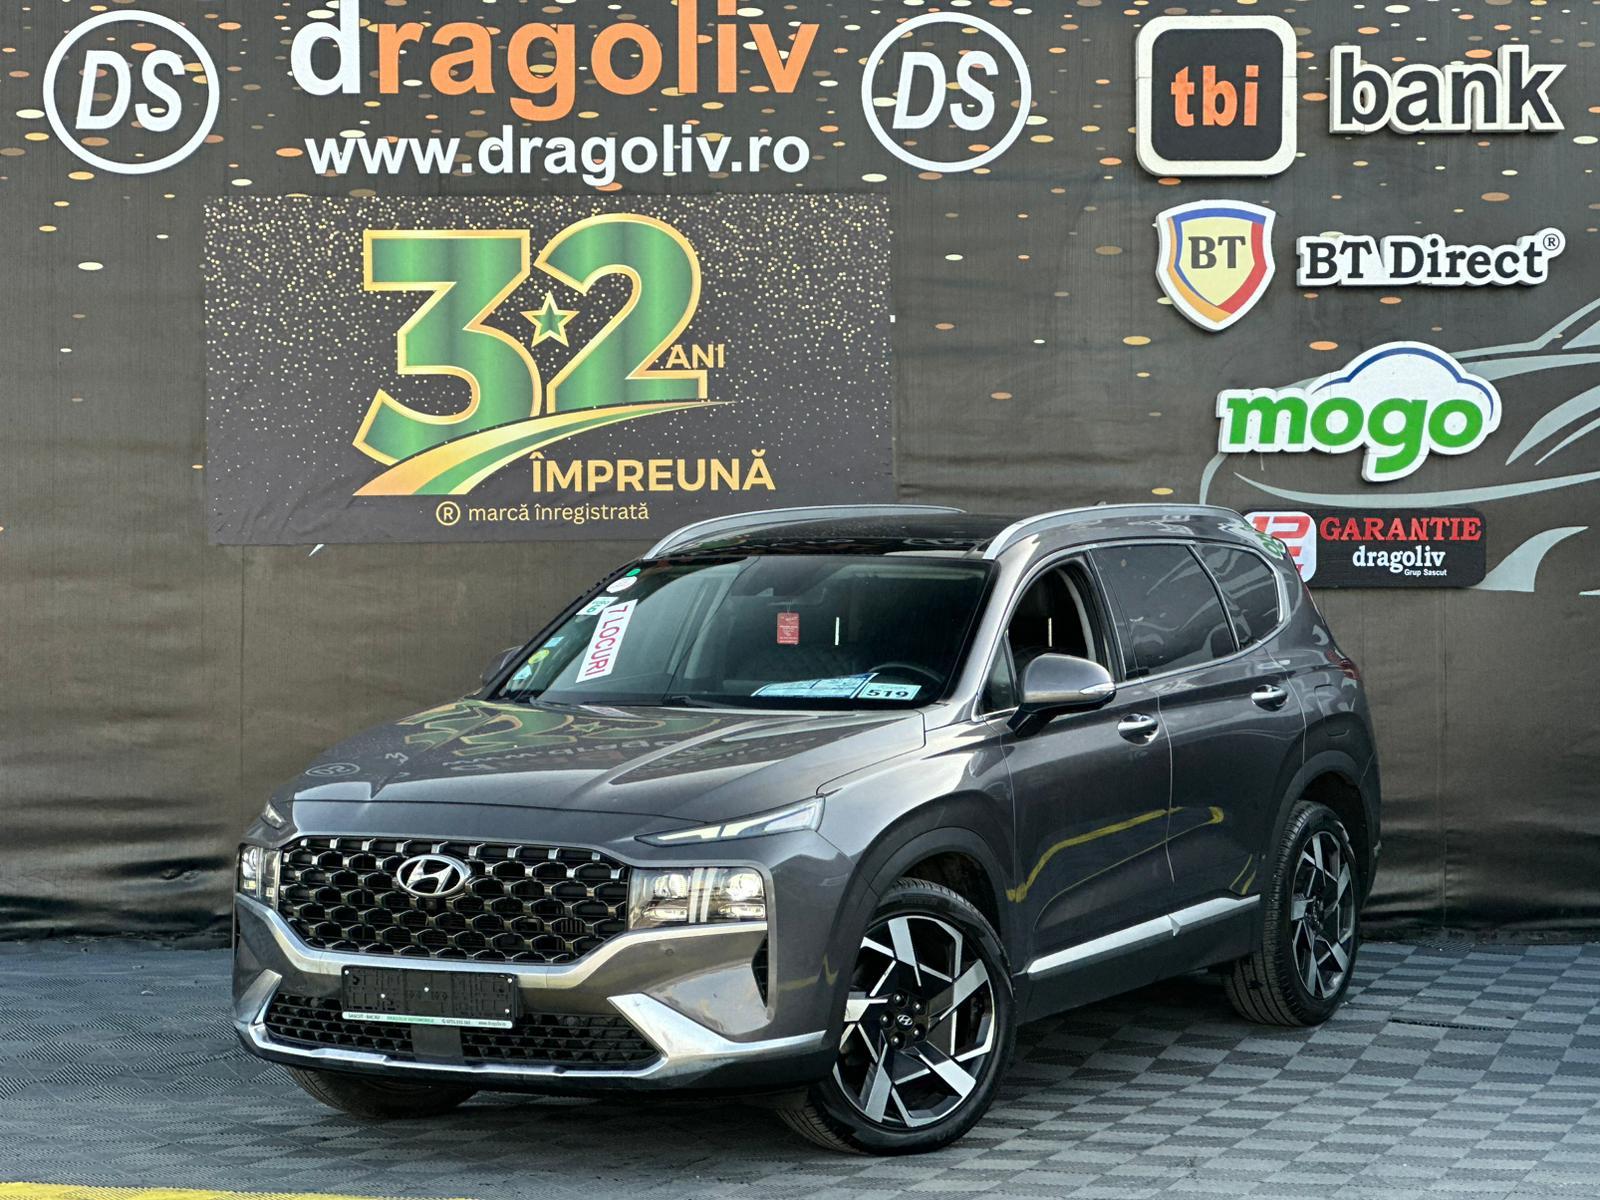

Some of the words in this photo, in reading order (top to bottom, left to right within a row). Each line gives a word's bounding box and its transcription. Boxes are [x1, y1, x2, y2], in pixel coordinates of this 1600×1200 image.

[76, 49, 185, 131] DS
[291, 0, 819, 121] dragoliv
[893, 51, 999, 130] DS
[1336, 48, 1560, 128] bank
[1170, 65, 1260, 127] tbi
[304, 124, 810, 187] www.dragoliv.ro
[1189, 236, 1246, 271] BT
[1304, 241, 1372, 279] BT
[352, 212, 708, 466] 32
[664, 344, 726, 369] ANI
[1226, 396, 1484, 474] mogo
[529, 448, 777, 493] ÎMPREUNĂ
[468, 504, 531, 522] marcă
[534, 502, 650, 525] înregistrată
[1319, 516, 1482, 541] GARANTIE
[1352, 545, 1447, 574] dragoliv
[1404, 568, 1422, 577] Grup
[1423, 568, 1448, 577] Sascut
[584, 616, 624, 677] LOCURI
